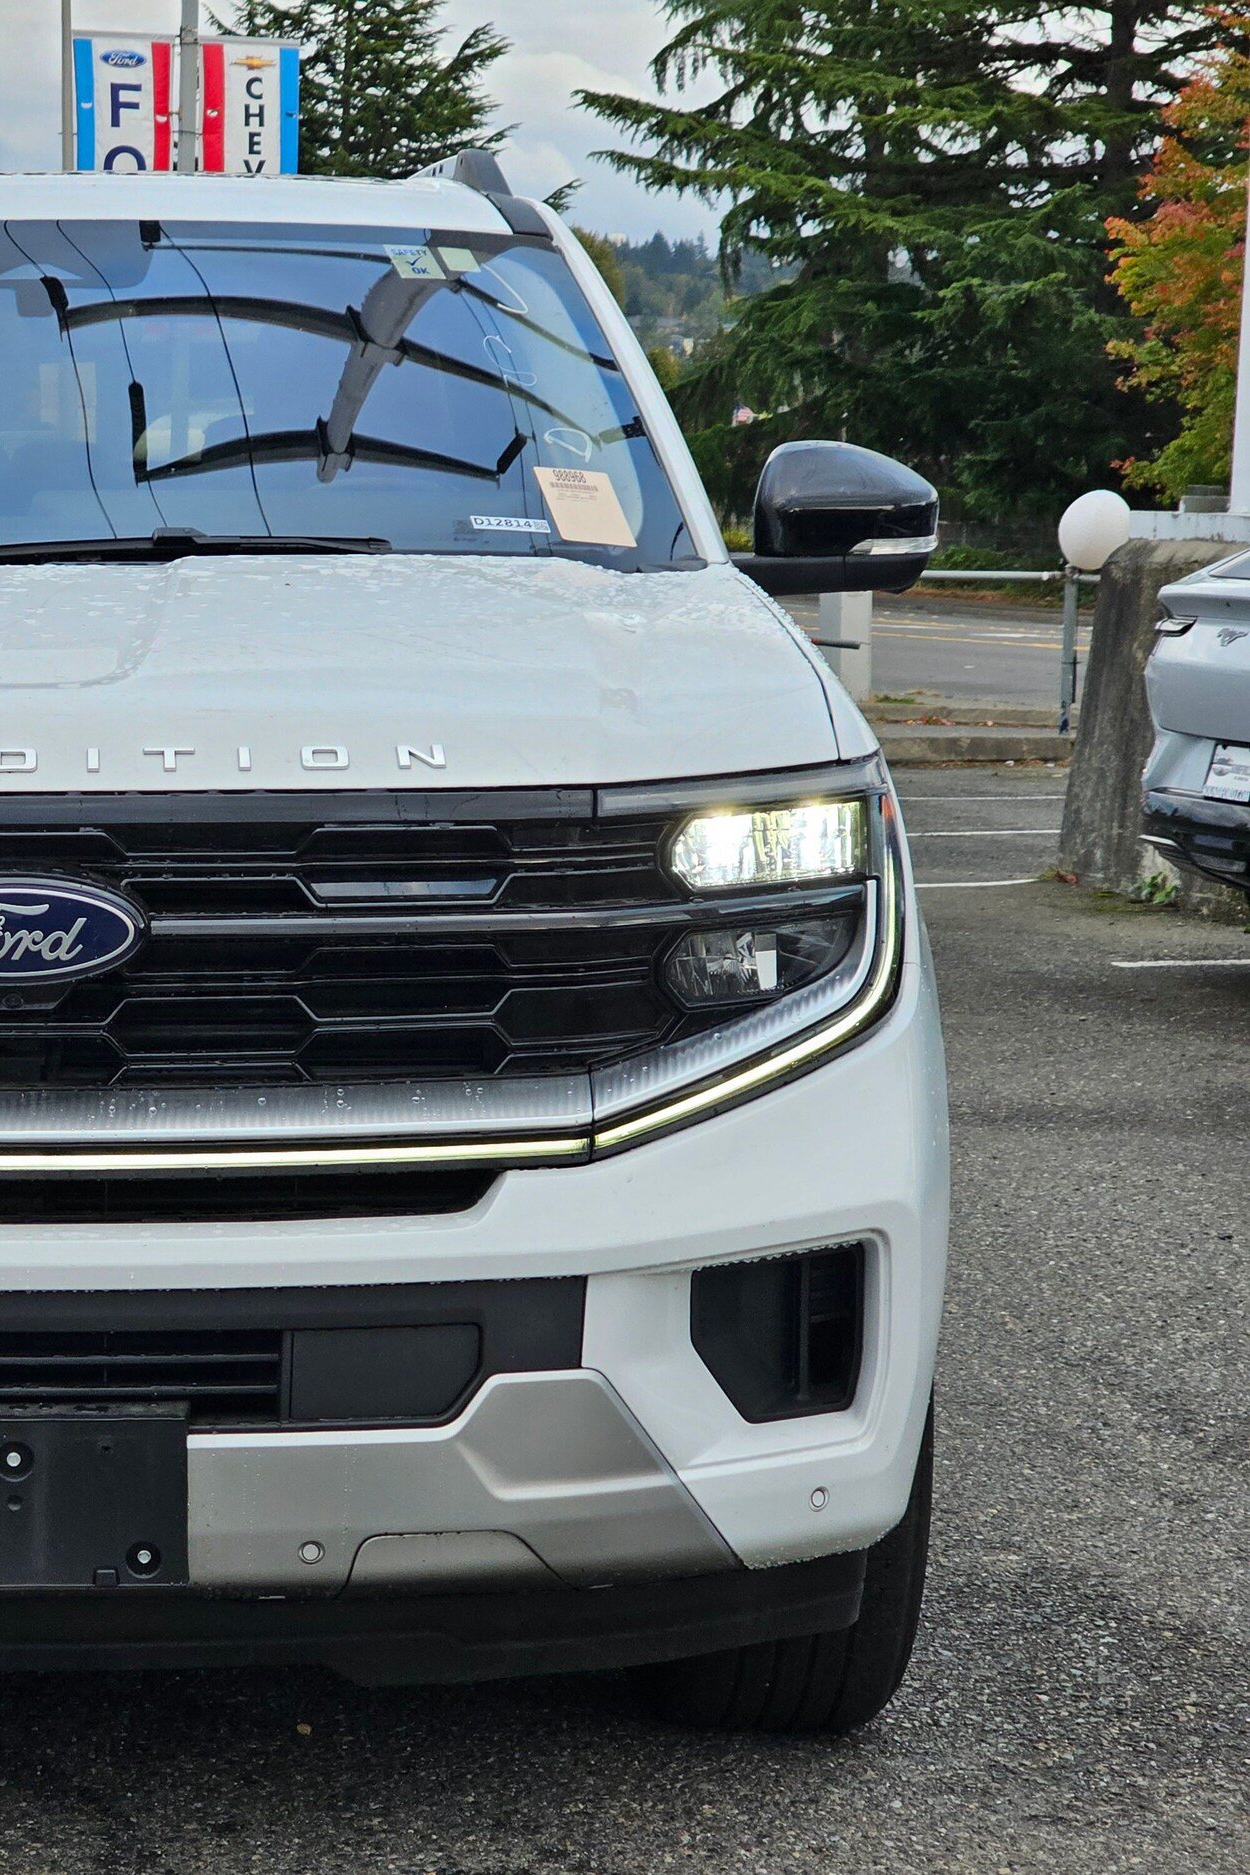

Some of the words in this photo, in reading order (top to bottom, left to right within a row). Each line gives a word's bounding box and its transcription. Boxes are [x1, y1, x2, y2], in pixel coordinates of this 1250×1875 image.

[107, 51, 140, 67] Ford
[412, 266, 430, 275] OK
[552, 469, 587, 484] 988968
[473, 516, 533, 529] D12814
